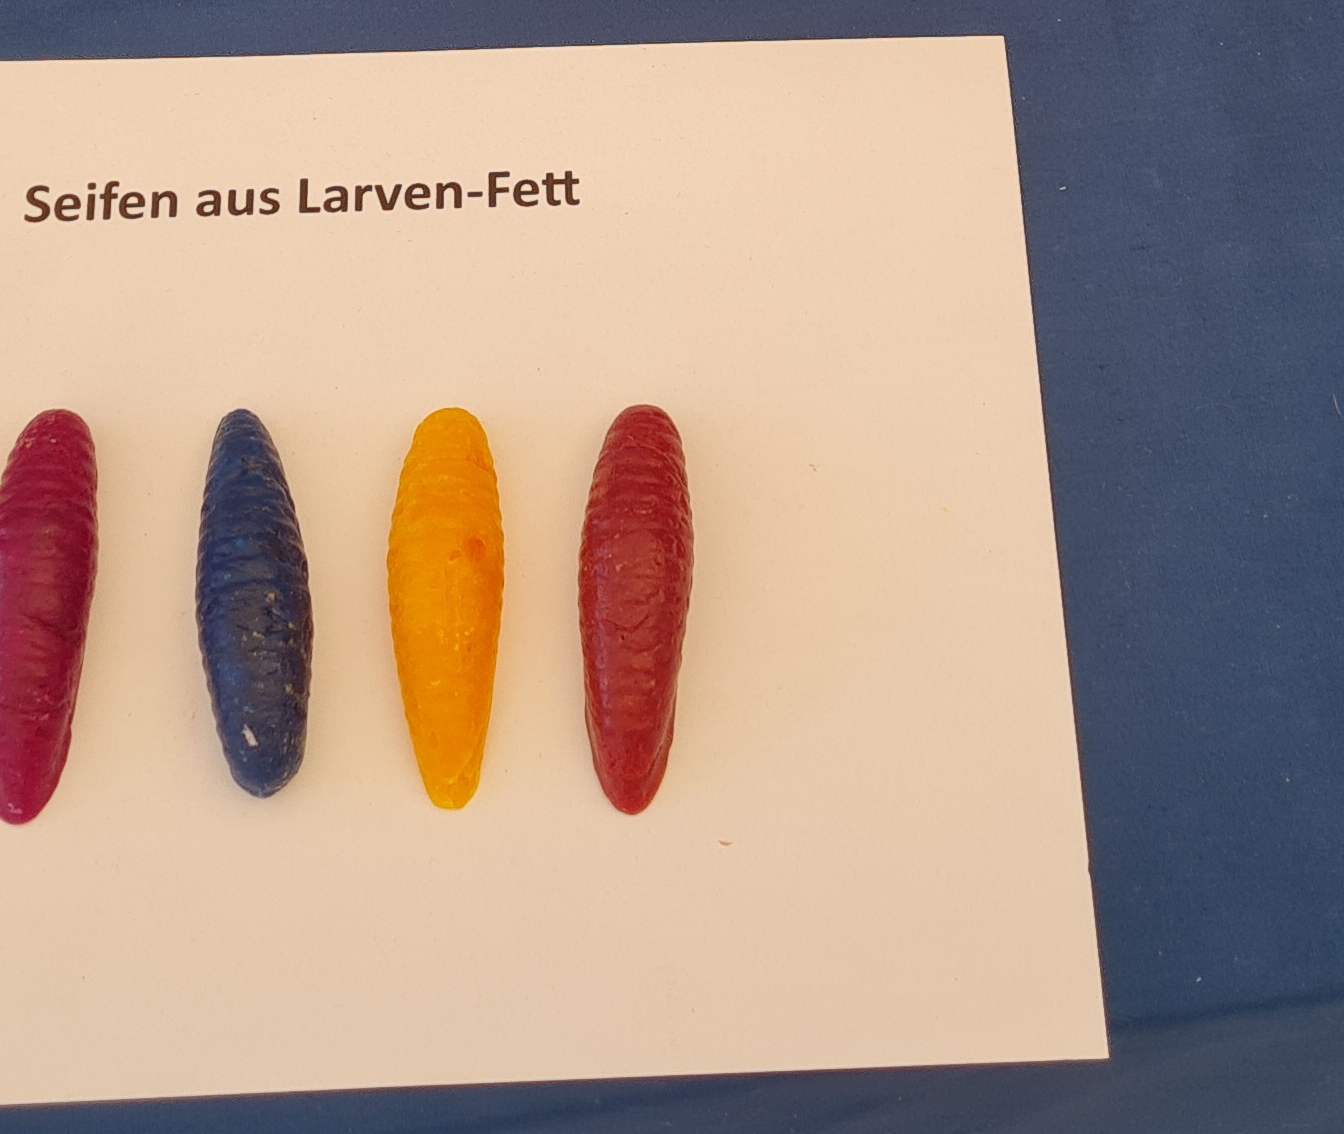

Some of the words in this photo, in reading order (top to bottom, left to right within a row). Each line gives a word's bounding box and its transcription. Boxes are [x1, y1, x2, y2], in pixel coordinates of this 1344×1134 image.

[23, 180, 178, 224] Seifen
[195, 187, 281, 218] aus
[298, 170, 581, 214] Larven-Fett
